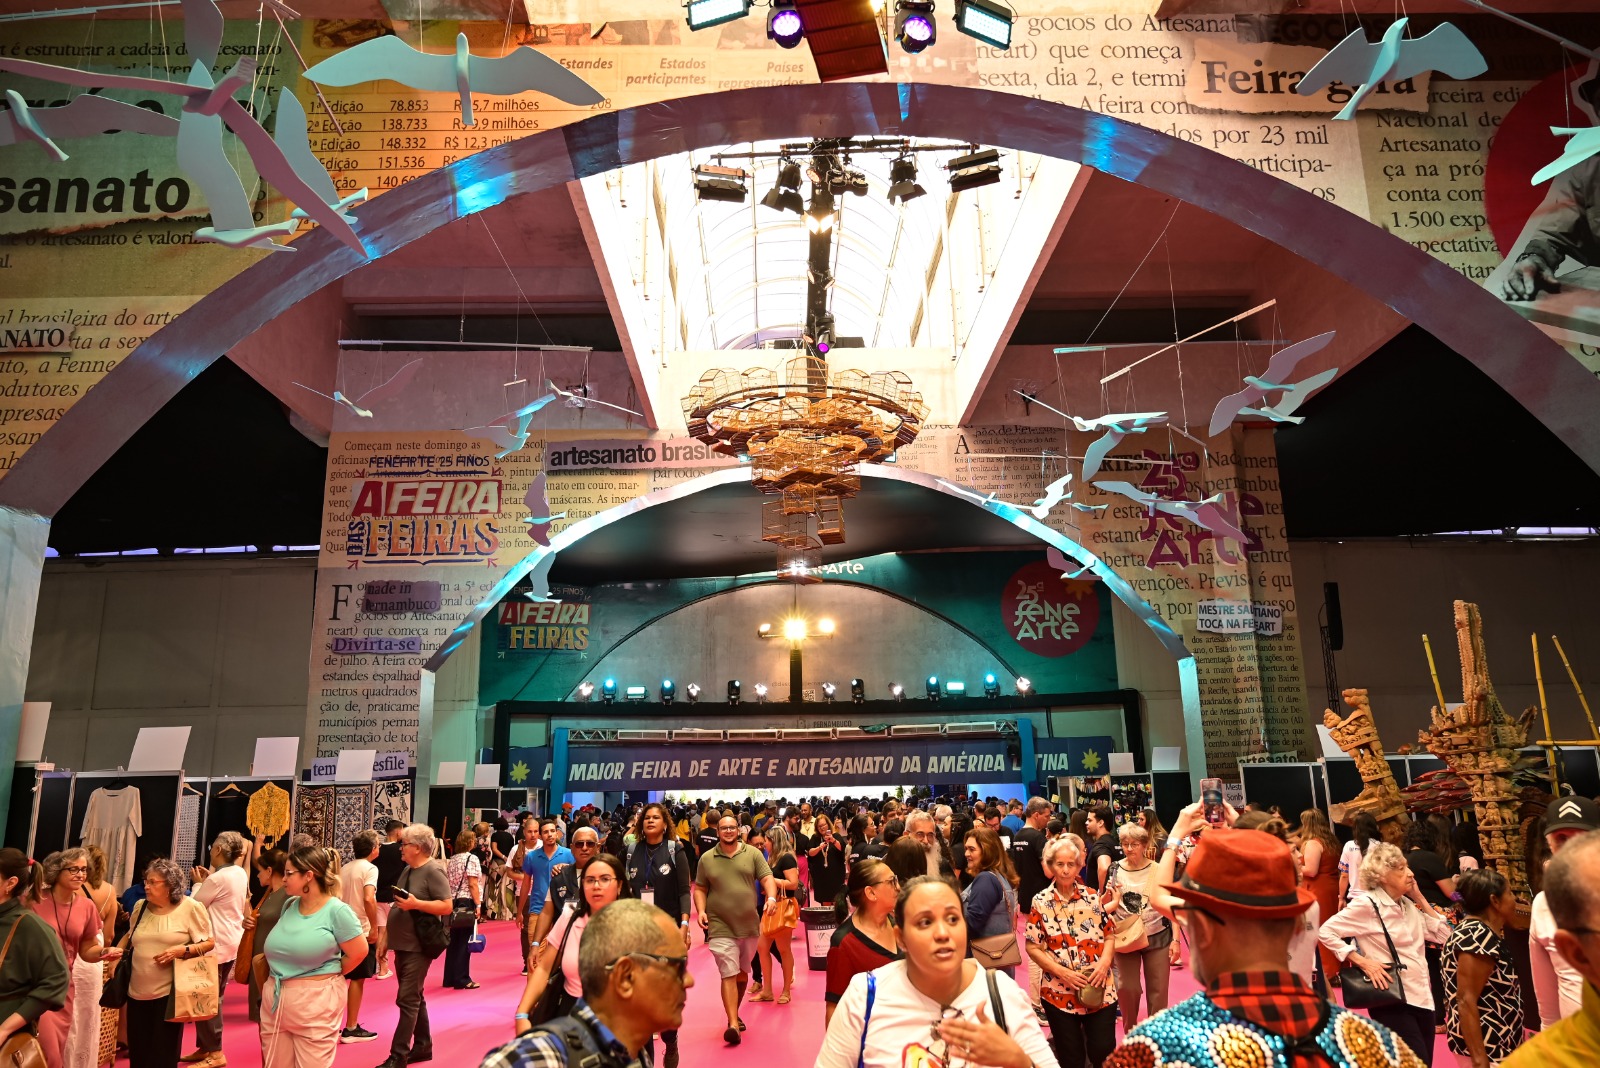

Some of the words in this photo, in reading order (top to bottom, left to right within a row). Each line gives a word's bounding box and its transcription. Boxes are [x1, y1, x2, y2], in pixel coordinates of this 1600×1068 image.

[1104, 14, 1133, 32] do
[1142, 14, 1238, 34] Artesanat
[26, 41, 104, 57] estruturar
[107, 45, 115, 57] a
[121, 40, 170, 57] cadeia
[1049, 45, 1089, 64] que
[1100, 44, 1183, 64] começa
[559, 58, 613, 70] Estandes
[659, 57, 706, 70] Estados
[766, 61, 804, 73] Países
[625, 73, 706, 87] participantes
[979, 70, 1038, 90] sexta,
[1046, 68, 1079, 87] dia
[1086, 68, 1104, 89] 2,
[1112, 72, 1125, 87] e
[390, 100, 429, 111] 78.853
[472, 101, 488, 114] 5,7
[493, 99, 540, 111] milhões
[1099, 93, 1145, 114] feira
[323, 117, 363, 133] Edição
[382, 118, 428, 131] 138.733
[491, 117, 539, 130] milhões
[1376, 112, 1469, 128] Nacional
[1478, 113, 1501, 128] de
[320, 137, 361, 152] Edição
[380, 137, 426, 150] 148.332
[444, 136, 459, 151] R$
[461, 137, 488, 152] 12,3
[1213, 128, 1251, 151] por
[1261, 125, 1285, 145] 23
[1295, 125, 1329, 145] mil
[1379, 137, 1481, 153] Artesanato
[378, 157, 425, 170] 151.536
[1383, 164, 1406, 183] ça
[1415, 164, 1442, 178] na
[1449, 161, 1486, 183] pró
[1387, 186, 1442, 203] conta
[1391, 211, 1445, 229] 1.500
[41, 230, 128, 246] artesanato
[132, 230, 142, 246] é
[113, 308, 138, 326] do
[98, 335, 110, 349] a
[38, 361, 49, 374] a
[344, 440, 393, 453] Começam
[396, 440, 421, 450] neste
[424, 440, 468, 453] domingo
[471, 441, 481, 450] as
[331, 454, 369, 465] oficinas
[439, 456, 453, 467] 25
[456, 455, 490, 467] ANOS
[550, 444, 657, 467] artesanato
[329, 486, 347, 497] que
[572, 482, 585, 491] em
[588, 482, 616, 493] couro,
[618, 482, 640, 491] mar-
[351, 481, 384, 517] A
[387, 482, 499, 514] FEIRA
[550, 494, 595, 505] máscaras.
[597, 494, 608, 504] As
[328, 513, 356, 523] Todos
[567, 508, 598, 519] feitas
[346, 521, 366, 556] DAS
[365, 518, 500, 557] FEIRAS
[514, 538, 538, 549] fone.
[399, 581, 412, 594] in
[1129, 573, 1195, 596] venções.
[1258, 570, 1267, 587] é
[1015, 579, 1045, 604] 25ª
[329, 585, 353, 621] F
[1168, 601, 1193, 620] por
[1198, 605, 1235, 616] MESTRE
[500, 603, 519, 625] A
[520, 603, 590, 625] FEIRA
[1016, 616, 1081, 641] Arte
[1199, 618, 1225, 629] TOCA
[1226, 618, 1241, 629] NA
[326, 625, 358, 637] neart)
[363, 628, 384, 640] que
[388, 627, 429, 638] começa
[434, 627, 447, 636] na
[509, 626, 590, 651] FEIRAS
[334, 637, 416, 652] Divirta-se
[324, 655, 338, 666] de
[340, 654, 370, 668] julho.
[372, 656, 380, 666] A
[382, 654, 406, 666] feira
[322, 670, 369, 681] estandes
[1213, 666, 1234, 674] maior
[1236, 664, 1255, 673] delas
[321, 685, 358, 697] metros
[362, 685, 418, 699] quadrados
[1208, 686, 1230, 696] Recife,
[1231, 685, 1258, 694] usando
[1277, 685, 1301, 693] metros
[319, 701, 340, 715] ção
[344, 700, 361, 713] de,
[1219, 706, 1255, 716] Artesanato
[318, 717, 378, 730] municípios
[813, 719, 852, 729] PERNAMBUCO
[317, 732, 382, 746] presentação
[384, 731, 398, 743] de
[1227, 726, 1254, 737] Roberto
[1291, 728, 1305, 737] que
[1231, 739, 1251, 747] ainda
[569, 762, 625, 782] MAIOR
[631, 760, 682, 780] FEIRA
[689, 759, 711, 778] DE
[718, 757, 763, 776] ARTE
[767, 758, 780, 777] E
[786, 755, 894, 777] ARTESANATO
[900, 755, 921, 774] DA
[927, 750, 1005, 775] AMÉRICA
[1012, 753, 1069, 772] LTINA
